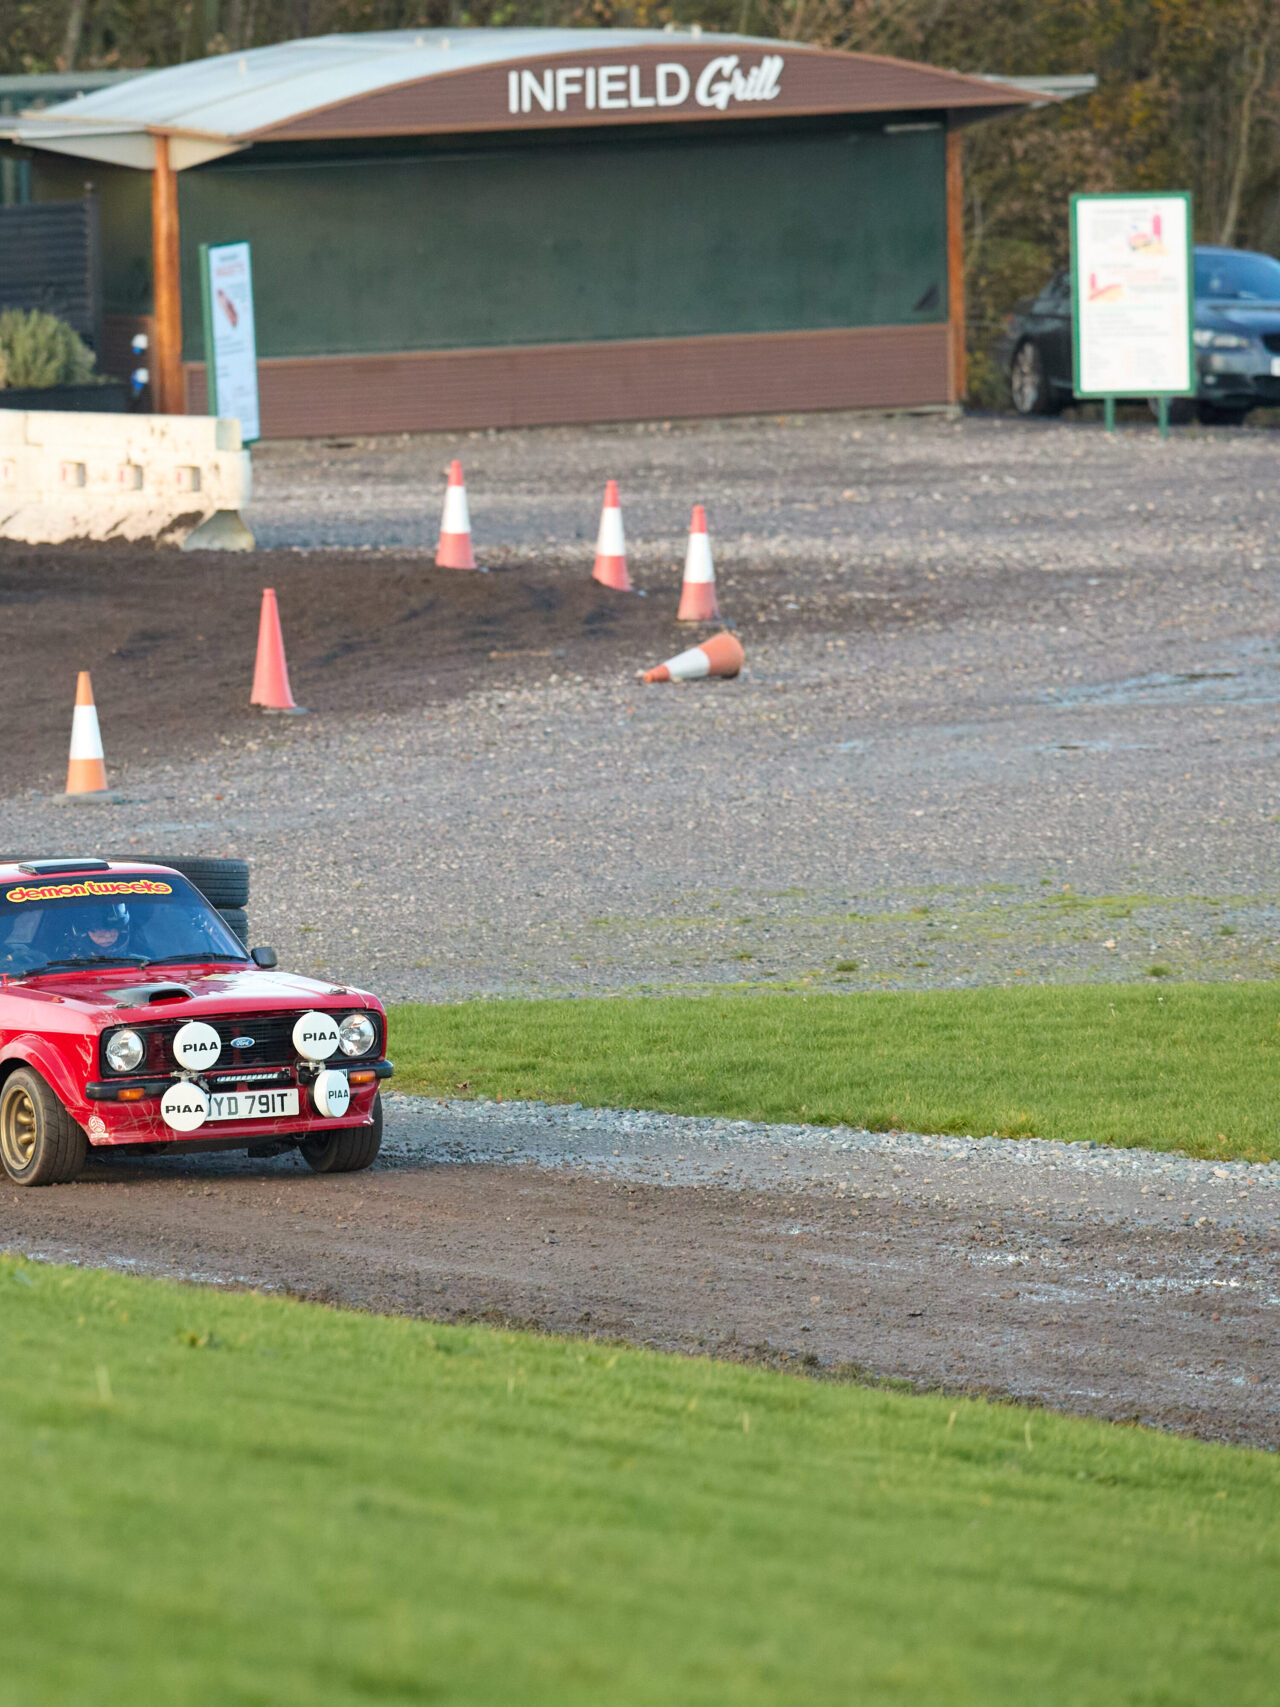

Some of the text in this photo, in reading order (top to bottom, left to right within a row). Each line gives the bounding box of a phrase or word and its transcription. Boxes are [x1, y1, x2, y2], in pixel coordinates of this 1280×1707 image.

[508, 54, 785, 114] INFIELD Grill
[6, 880, 172, 903] demon tweeks
[303, 1031, 337, 1042] PIAA
[183, 1041, 219, 1053] PIAA
[328, 1090, 349, 1099] PIAA
[165, 1104, 205, 1114] PIAA
[244, 1092, 288, 1115] 791T
